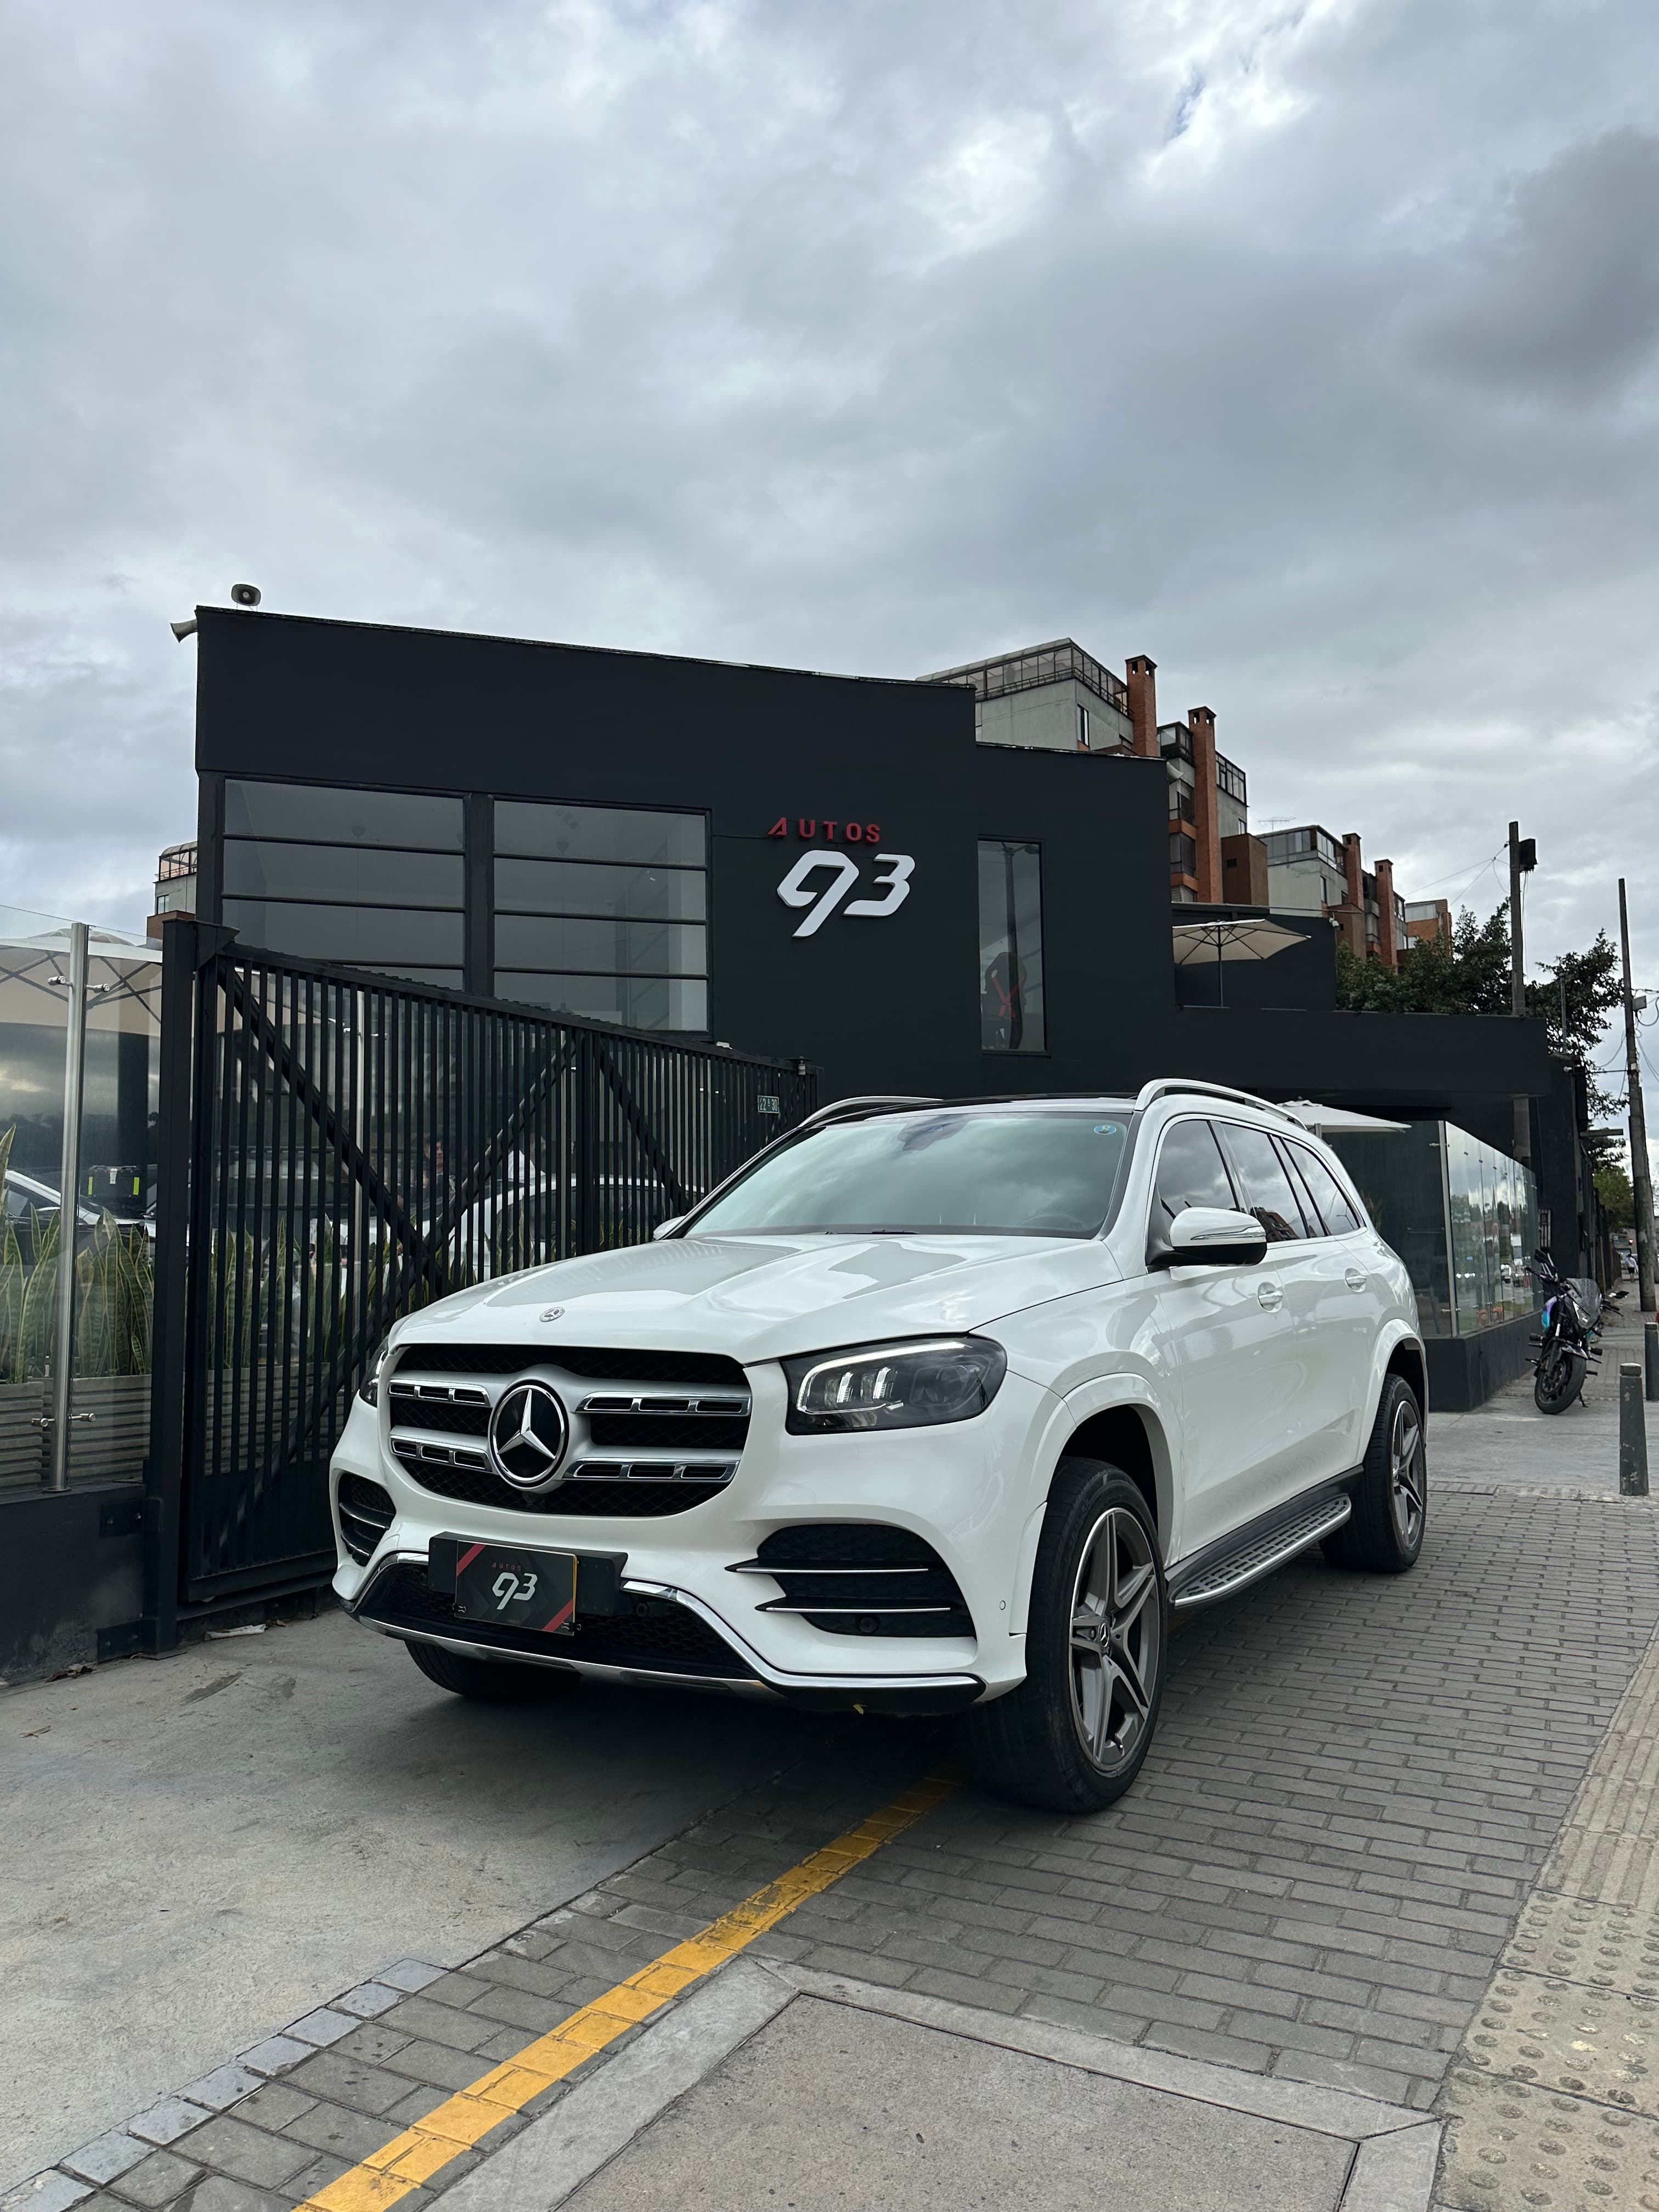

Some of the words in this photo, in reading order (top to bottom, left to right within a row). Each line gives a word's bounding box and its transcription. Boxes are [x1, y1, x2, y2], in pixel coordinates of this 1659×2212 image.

[768, 817, 880, 843] AUTOS
[777, 850, 916, 938] 93
[492, 1562, 522, 1571] AUTOS
[492, 1572, 538, 1610] 93
